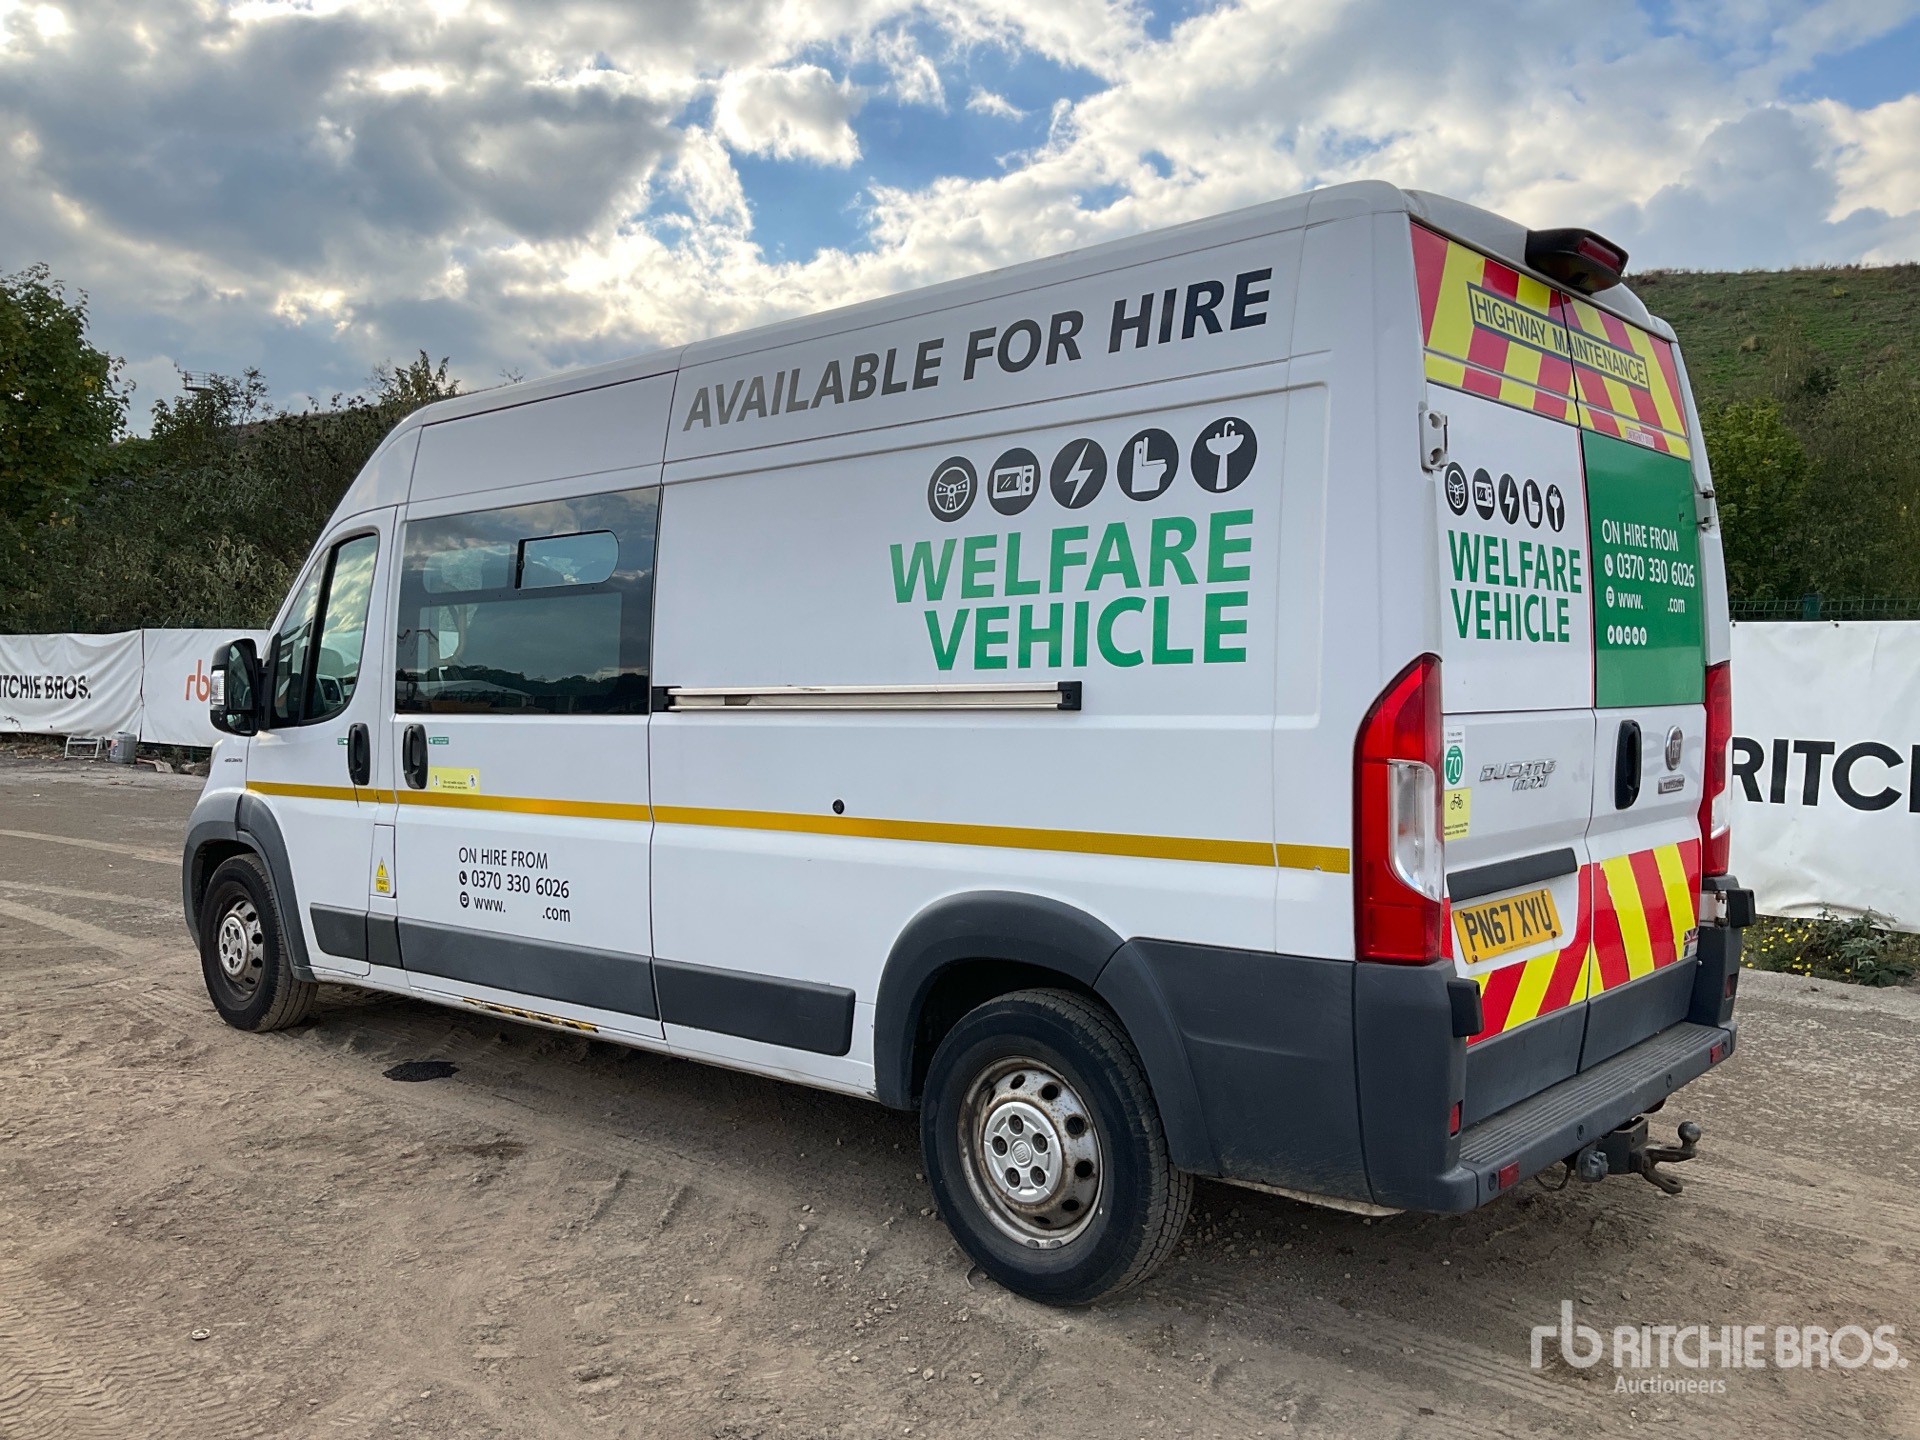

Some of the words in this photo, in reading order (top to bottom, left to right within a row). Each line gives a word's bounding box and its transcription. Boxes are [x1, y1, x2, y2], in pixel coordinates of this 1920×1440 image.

[682, 338, 945, 432] AVAILABLE
[963, 310, 1084, 381] FOR
[1108, 267, 1273, 354] HIRE
[1474, 294, 1546, 346] HIGHWAY
[1552, 327, 1646, 384] MAINTENANCE
[1602, 519, 1621, 545] ON
[1623, 522, 1648, 549] HIRE
[1649, 526, 1679, 552] FROM
[890, 509, 1254, 603] WELFARE
[1447, 529, 1582, 594] WELFARE
[1616, 552, 1645, 581] 0370
[1648, 557, 1668, 584] 330
[1671, 561, 1695, 588] 6026
[1450, 588, 1570, 643] VEHICLE
[1617, 592, 1644, 610] www.
[1667, 598, 1686, 613] .com
[924, 591, 1248, 670] VEHICLE
[45, 675, 91, 699] BROS.
[1447, 756, 1462, 778] 70
[1479, 758, 1557, 782] DUCATO
[459, 847, 477, 863] ON
[481, 848, 507, 866] HIRE
[511, 850, 548, 869] FROM
[471, 869, 502, 890] 0370
[507, 873, 531, 894] 330
[536, 877, 570, 899] 6026
[473, 896, 506, 913] www.
[542, 907, 571, 922] .com
[1464, 904, 1514, 952] PN67
[1513, 890, 1552, 938] XYU
